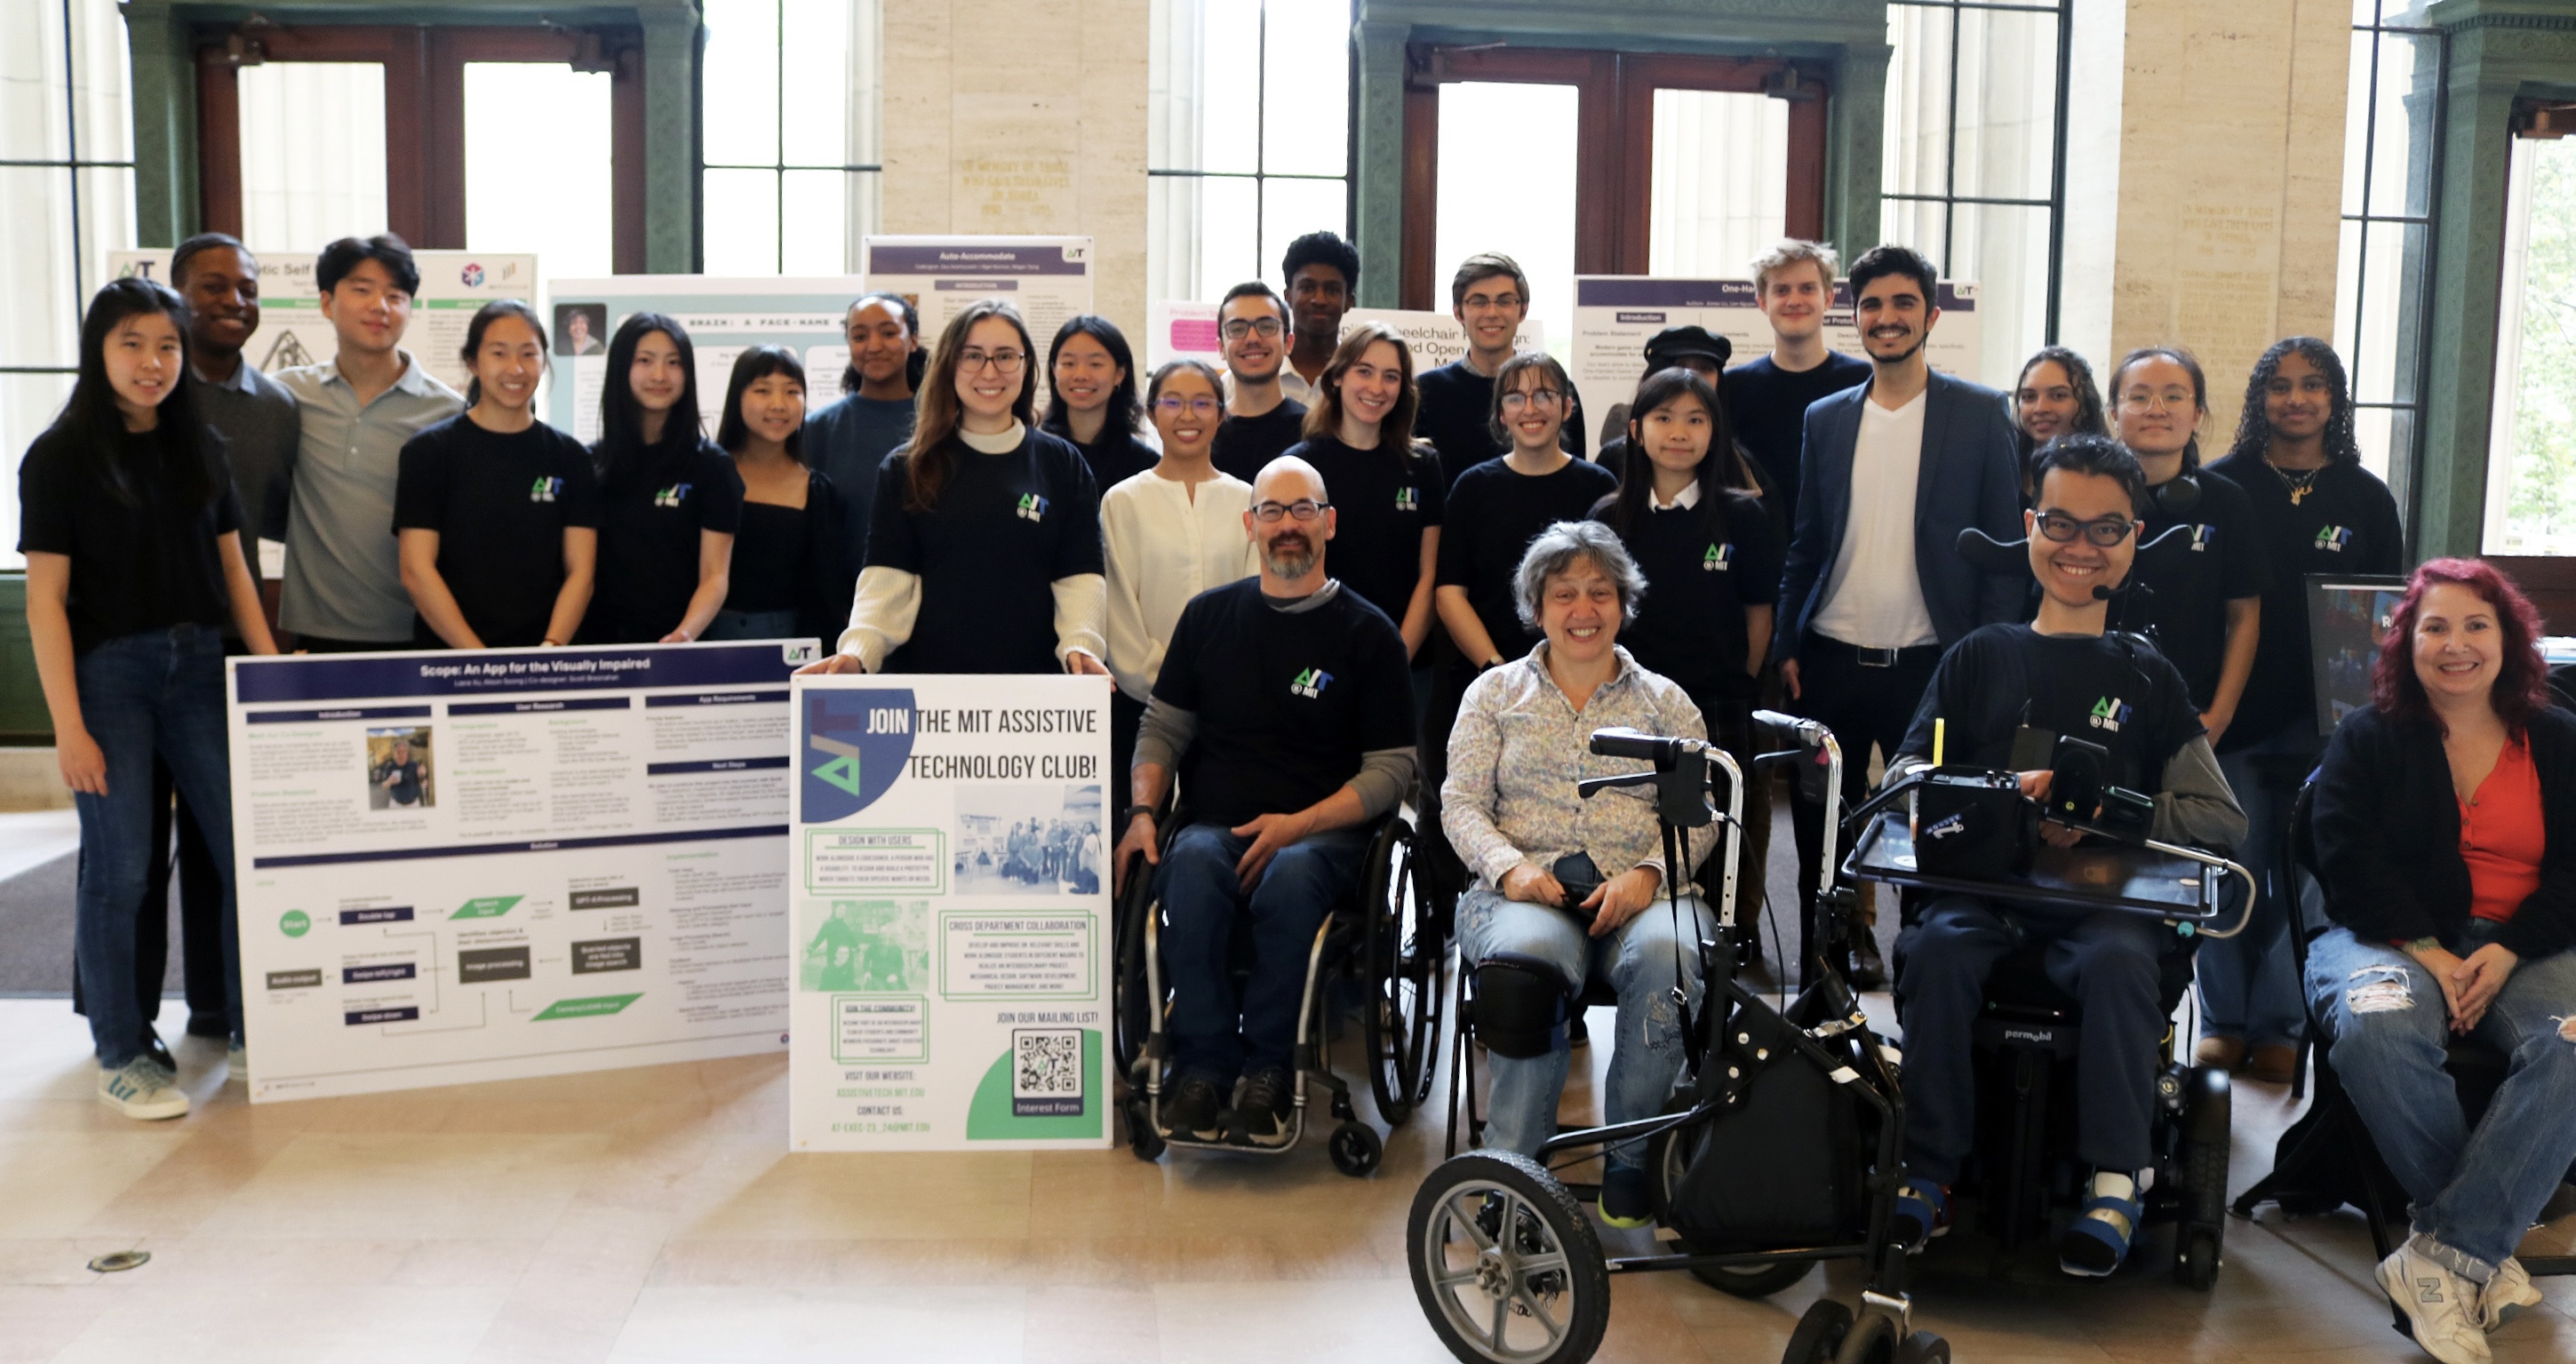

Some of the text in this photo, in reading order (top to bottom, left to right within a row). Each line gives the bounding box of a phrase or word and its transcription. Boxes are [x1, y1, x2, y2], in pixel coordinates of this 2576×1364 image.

[1426, 343, 1464, 355] Open
[2326, 540, 2341, 553] MIT
[419, 658, 650, 678] Scope: An App for the Visually Impaired
[866, 707, 1097, 734] JOIN THE MIT ASSISTIVE
[2102, 717, 2119, 732] MIT
[911, 755, 1097, 779] TECHNOLOGY CLUB!
[839, 835, 912, 845] DESIGN WITH USERS
[283, 919, 307, 929] Start
[949, 921, 1087, 930] CROSS DEPARTMENT COLLABORATION
[997, 1012, 1098, 1024] JOIN OUR MAILING LIST!
[2006, 1030, 2052, 1042] permobil
[844, 1071, 863, 1081] VISIT
[865, 1071, 880, 1081] OUR
[857, 1105, 889, 1115] CONTACT
[1017, 1103, 1080, 1113] Interest Form
[2417, 1277, 2444, 1304] N
